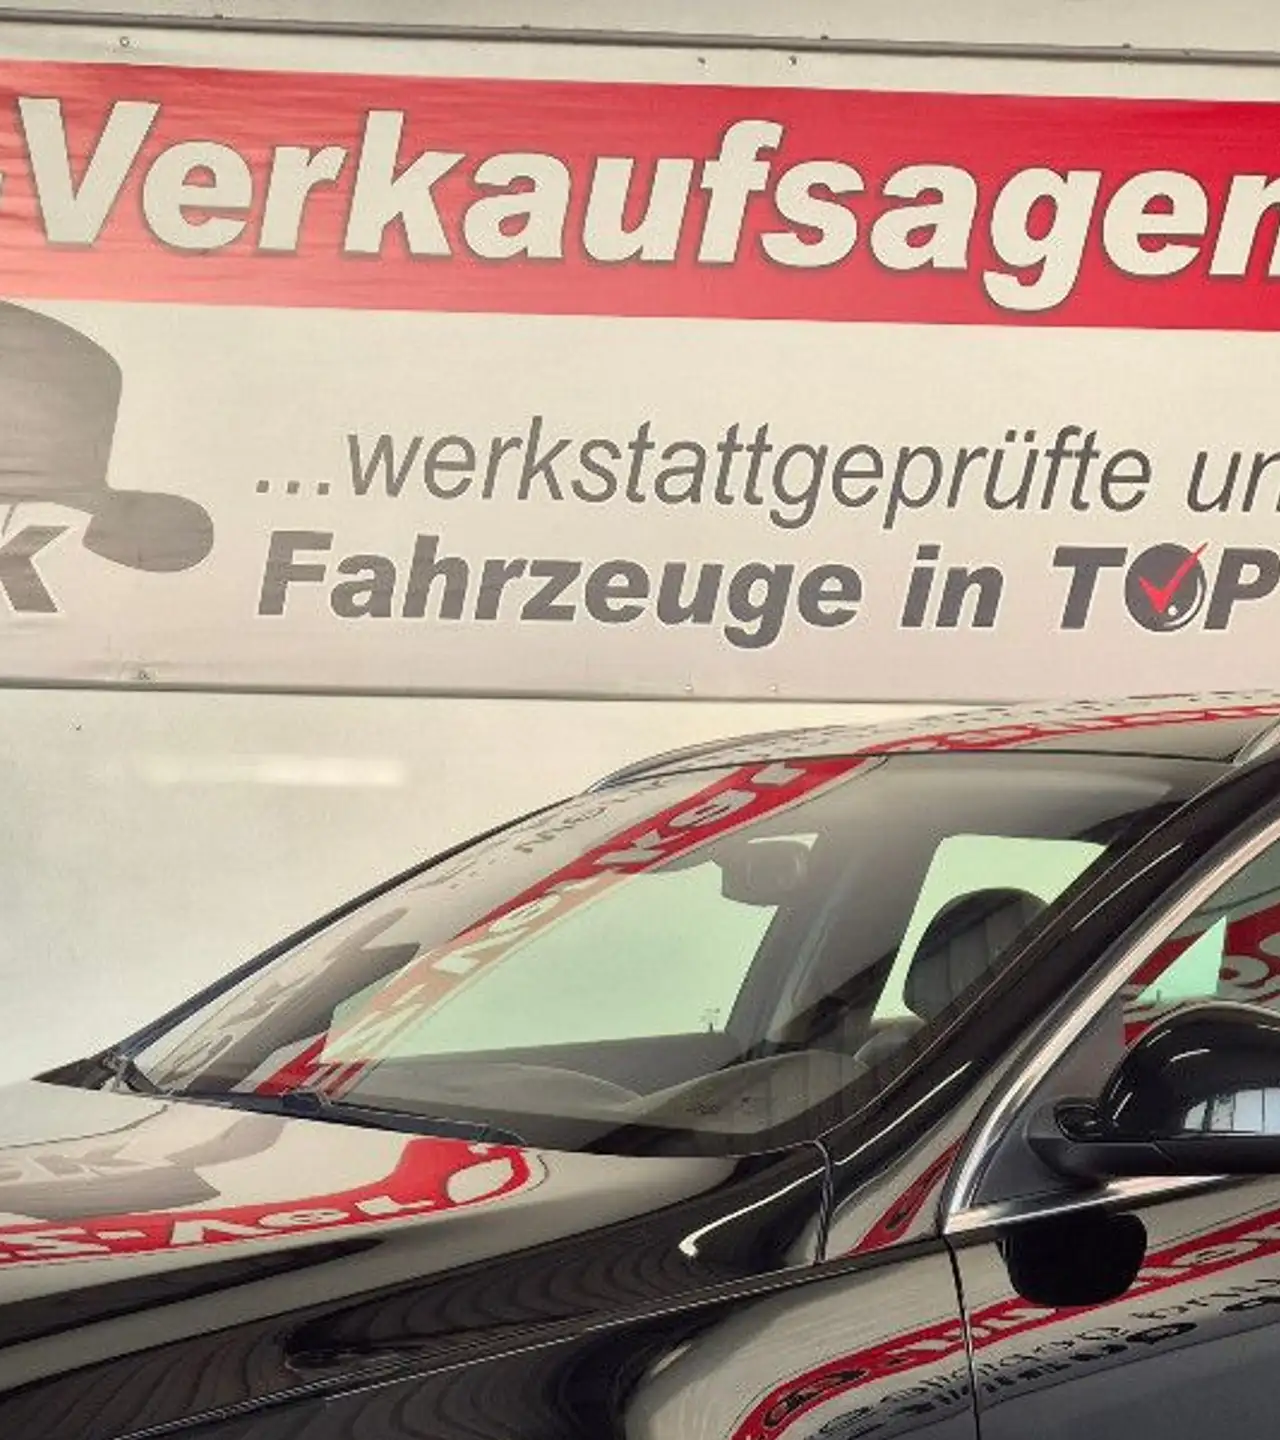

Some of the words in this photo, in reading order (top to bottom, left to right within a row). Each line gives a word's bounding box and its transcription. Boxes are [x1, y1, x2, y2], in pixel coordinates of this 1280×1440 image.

[255, 416, 1151, 530] ...werkstattgeprüfte
[257, 531, 864, 649] Fahrzeuge
[901, 544, 1004, 629] in
